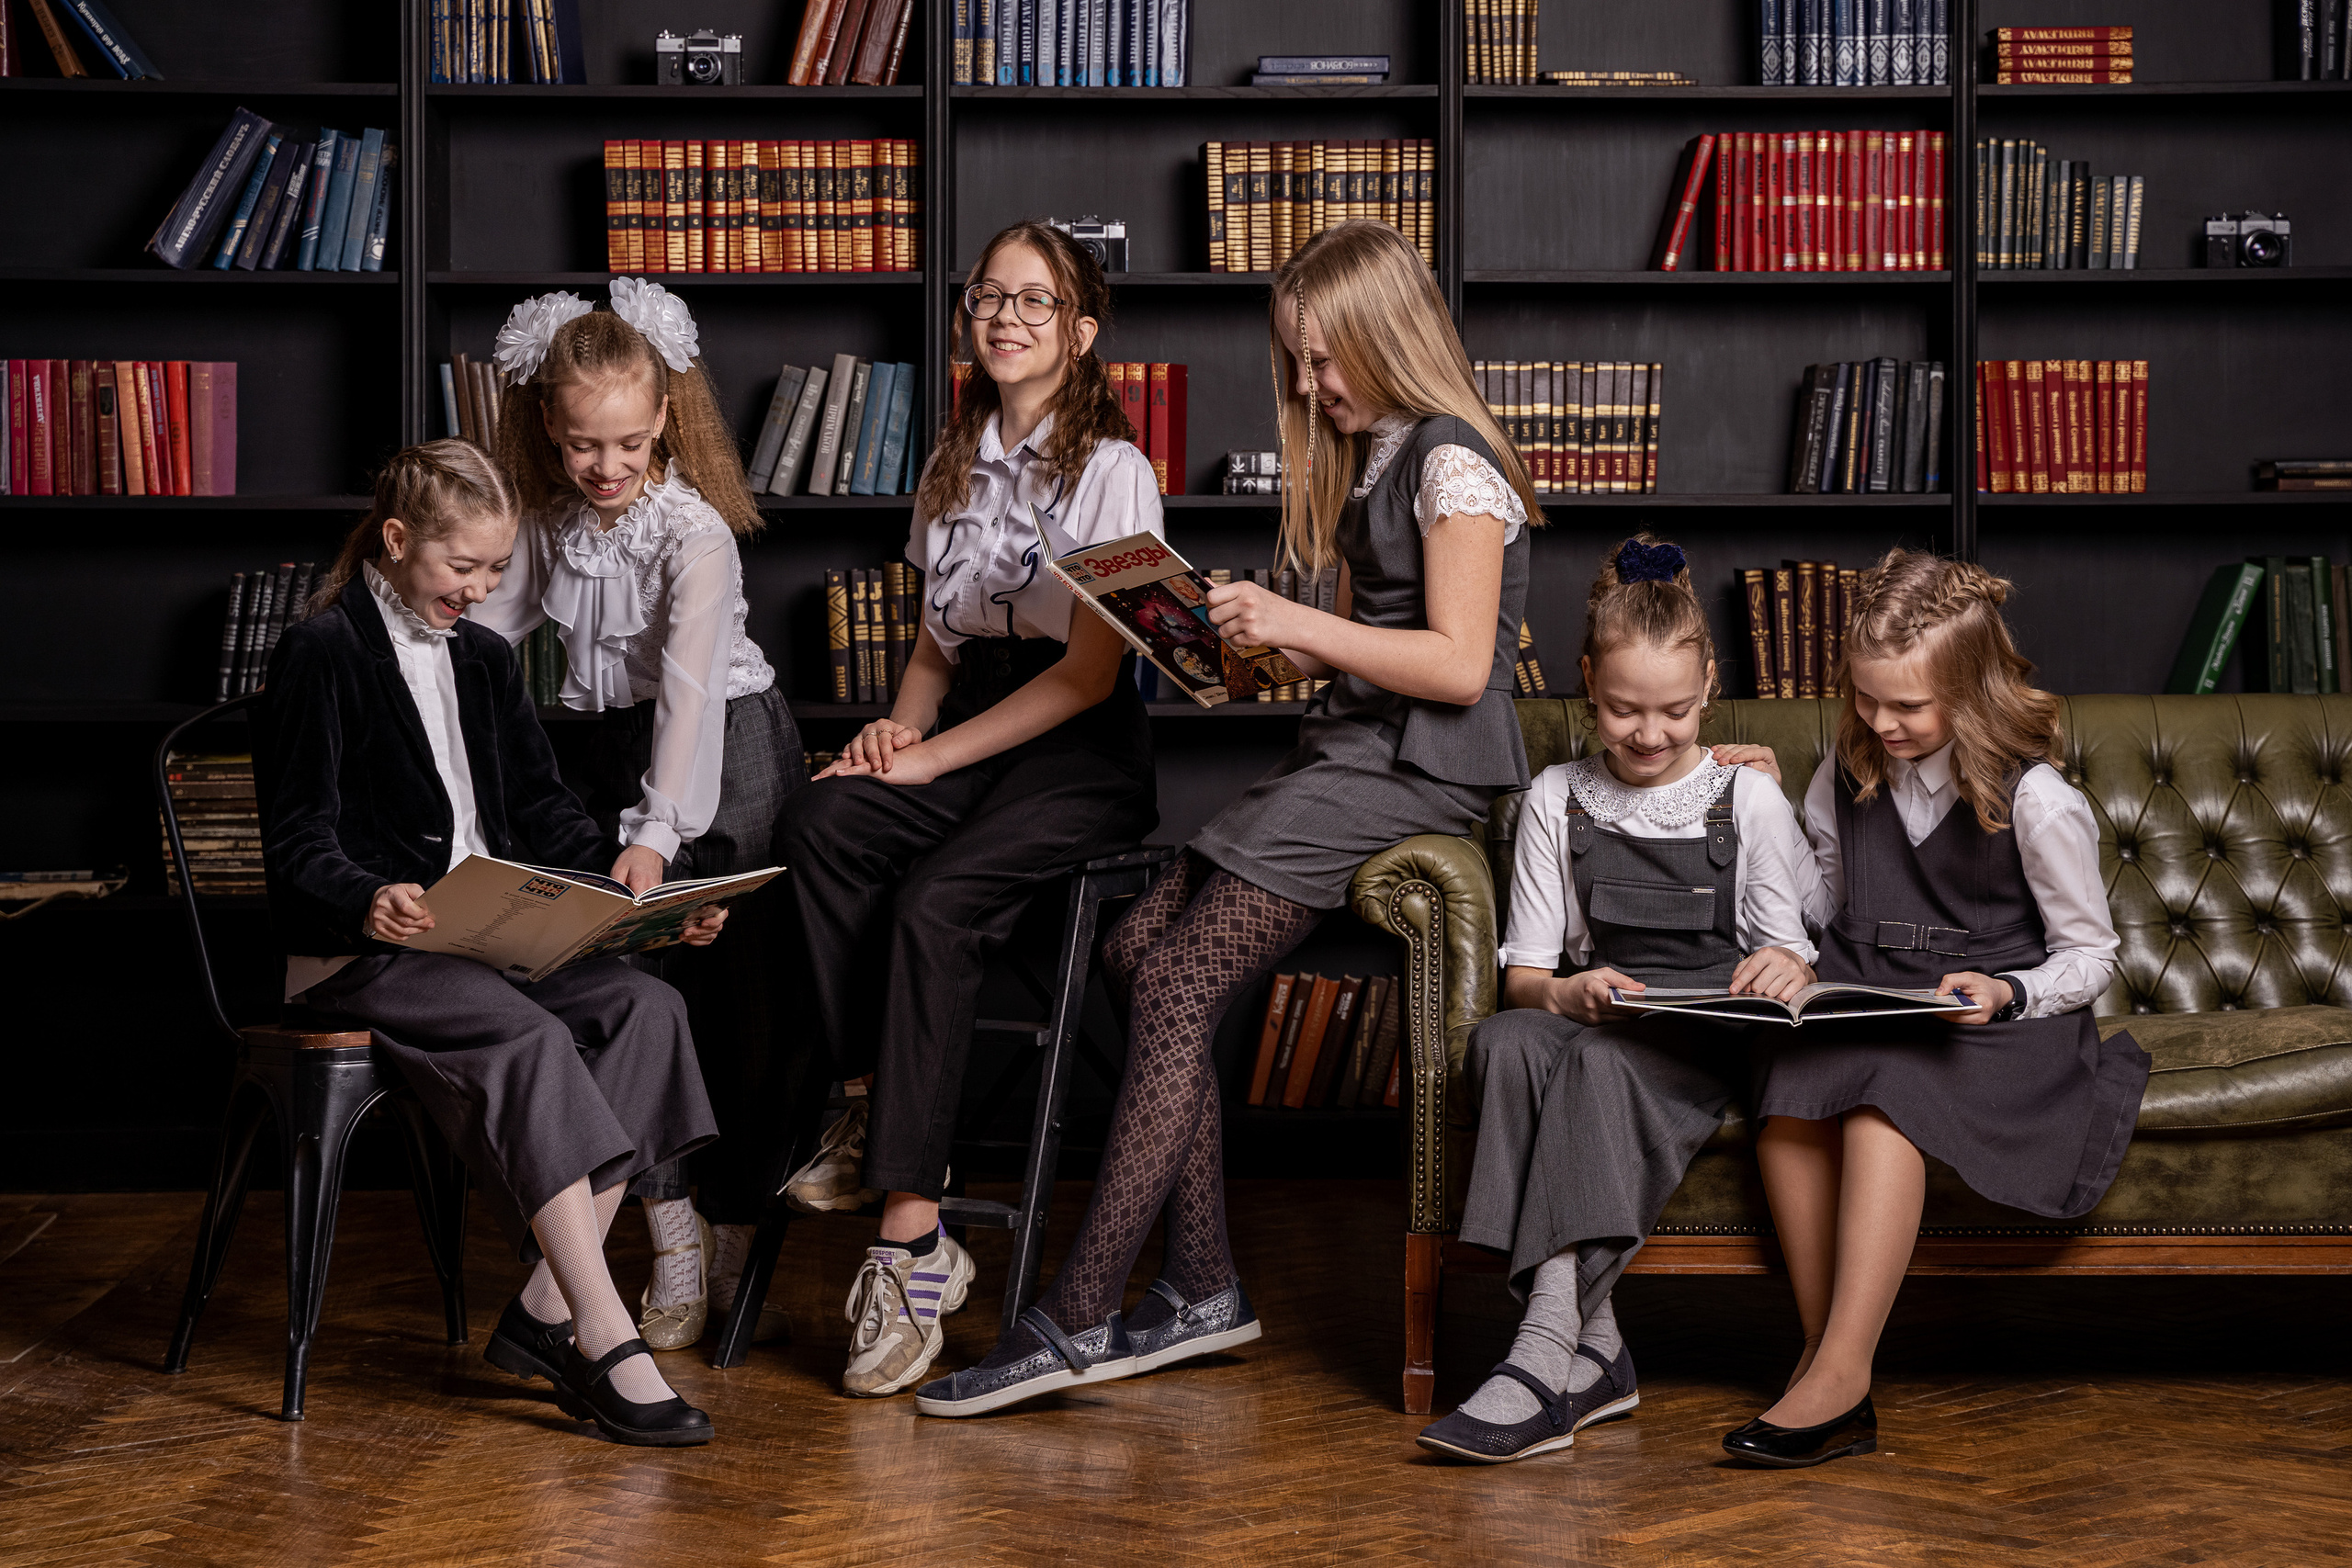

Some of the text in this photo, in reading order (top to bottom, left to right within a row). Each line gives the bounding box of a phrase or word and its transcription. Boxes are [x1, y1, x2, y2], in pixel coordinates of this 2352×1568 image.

[2022, 30, 2095, 39] BRIDLEWAY
[2019, 45, 2095, 55] BRIDLEWAY
[2023, 59, 2095, 69] BRIDLEWAY
[1023, 65, 1030, 83] 1
[1059, 68, 1071, 86] 3
[1076, 70, 1088, 86] 4
[1130, 70, 1141, 86] 7
[1146, 69, 1158, 85] 8
[2021, 73, 2094, 84] BRIDLEWAY
[175, 168, 224, 252] АНГЛО-РУССКИЙ
[219, 123, 251, 170] СЛОВАРЬ
[2092, 183, 2106, 254] BRIDLEWAY
[2112, 184, 2125, 254] BRIDLEWAY
[2128, 181, 2143, 254] BRIDLEWAY
[32, 374, 44, 423] ДЕТЕКТИВА
[1127, 386, 1140, 402] 9
[1152, 389, 1166, 406] A
[1833, 387, 1846, 411] Прага
[820, 403, 838, 454] ПРИМАКОВ
[1807, 432, 1822, 485] ГЕРБЕРТ
[1065, 564, 1081, 574] ЧТО
[1084, 543, 1172, 578] Звезды
[1052, 570, 1062, 581] ЧТО
[1062, 579, 1074, 591] ЕСТЬ
[1073, 589, 1083, 599] ЧТО
[1075, 572, 1092, 583] ЧТО
[261, 585, 274, 617] SIDE
[275, 575, 289, 615] WALK
[293, 575, 311, 615] WALK
[1781, 598, 1790, 634] Railroad
[836, 666, 847, 697] BRID
[857, 650, 865, 686] Railroad
[1516, 662, 1531, 693] BRID
[1528, 660, 1545, 691] BRID
[526, 886, 556, 897] ЧТО
[535, 878, 565, 889] ЧТО
